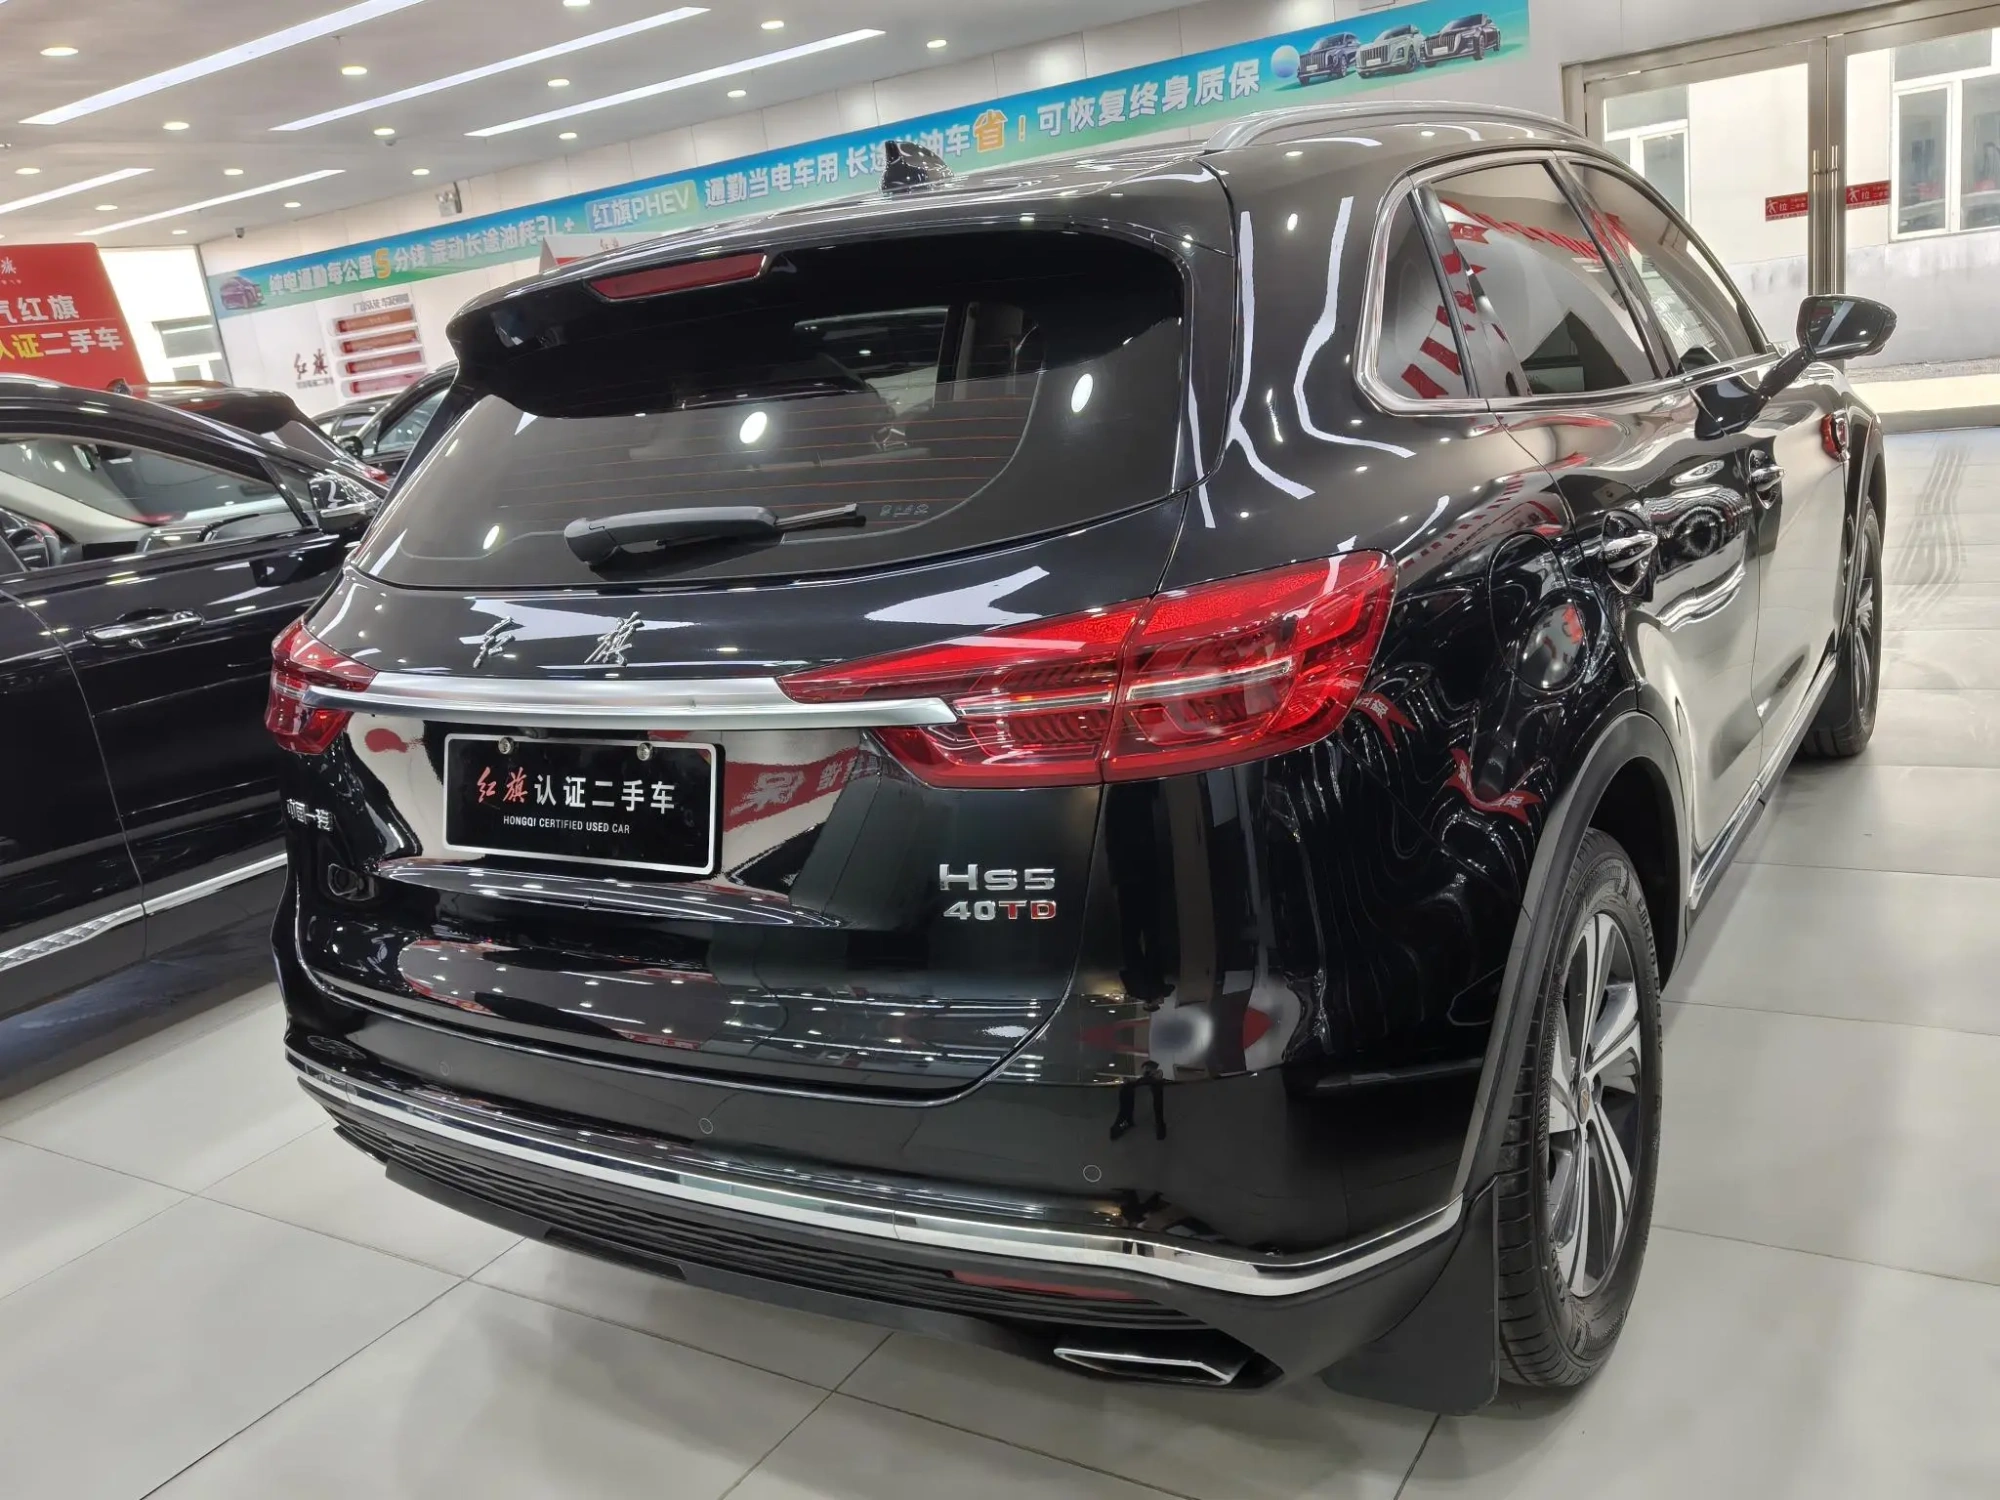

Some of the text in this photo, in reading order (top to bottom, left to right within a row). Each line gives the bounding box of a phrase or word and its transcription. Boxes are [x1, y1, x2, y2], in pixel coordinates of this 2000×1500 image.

[592, 186, 689, 230] 红旗PHEV
[703, 152, 839, 209] 通勤当电车用
[1037, 58, 1261, 137] 可恢复终身质保
[476, 766, 675, 815] 红旗认证二手车
[503, 815, 631, 834] HONGQI CERTIFIED USED CAR
[938, 863, 1056, 891] HS5
[943, 899, 1057, 921] 40TD
